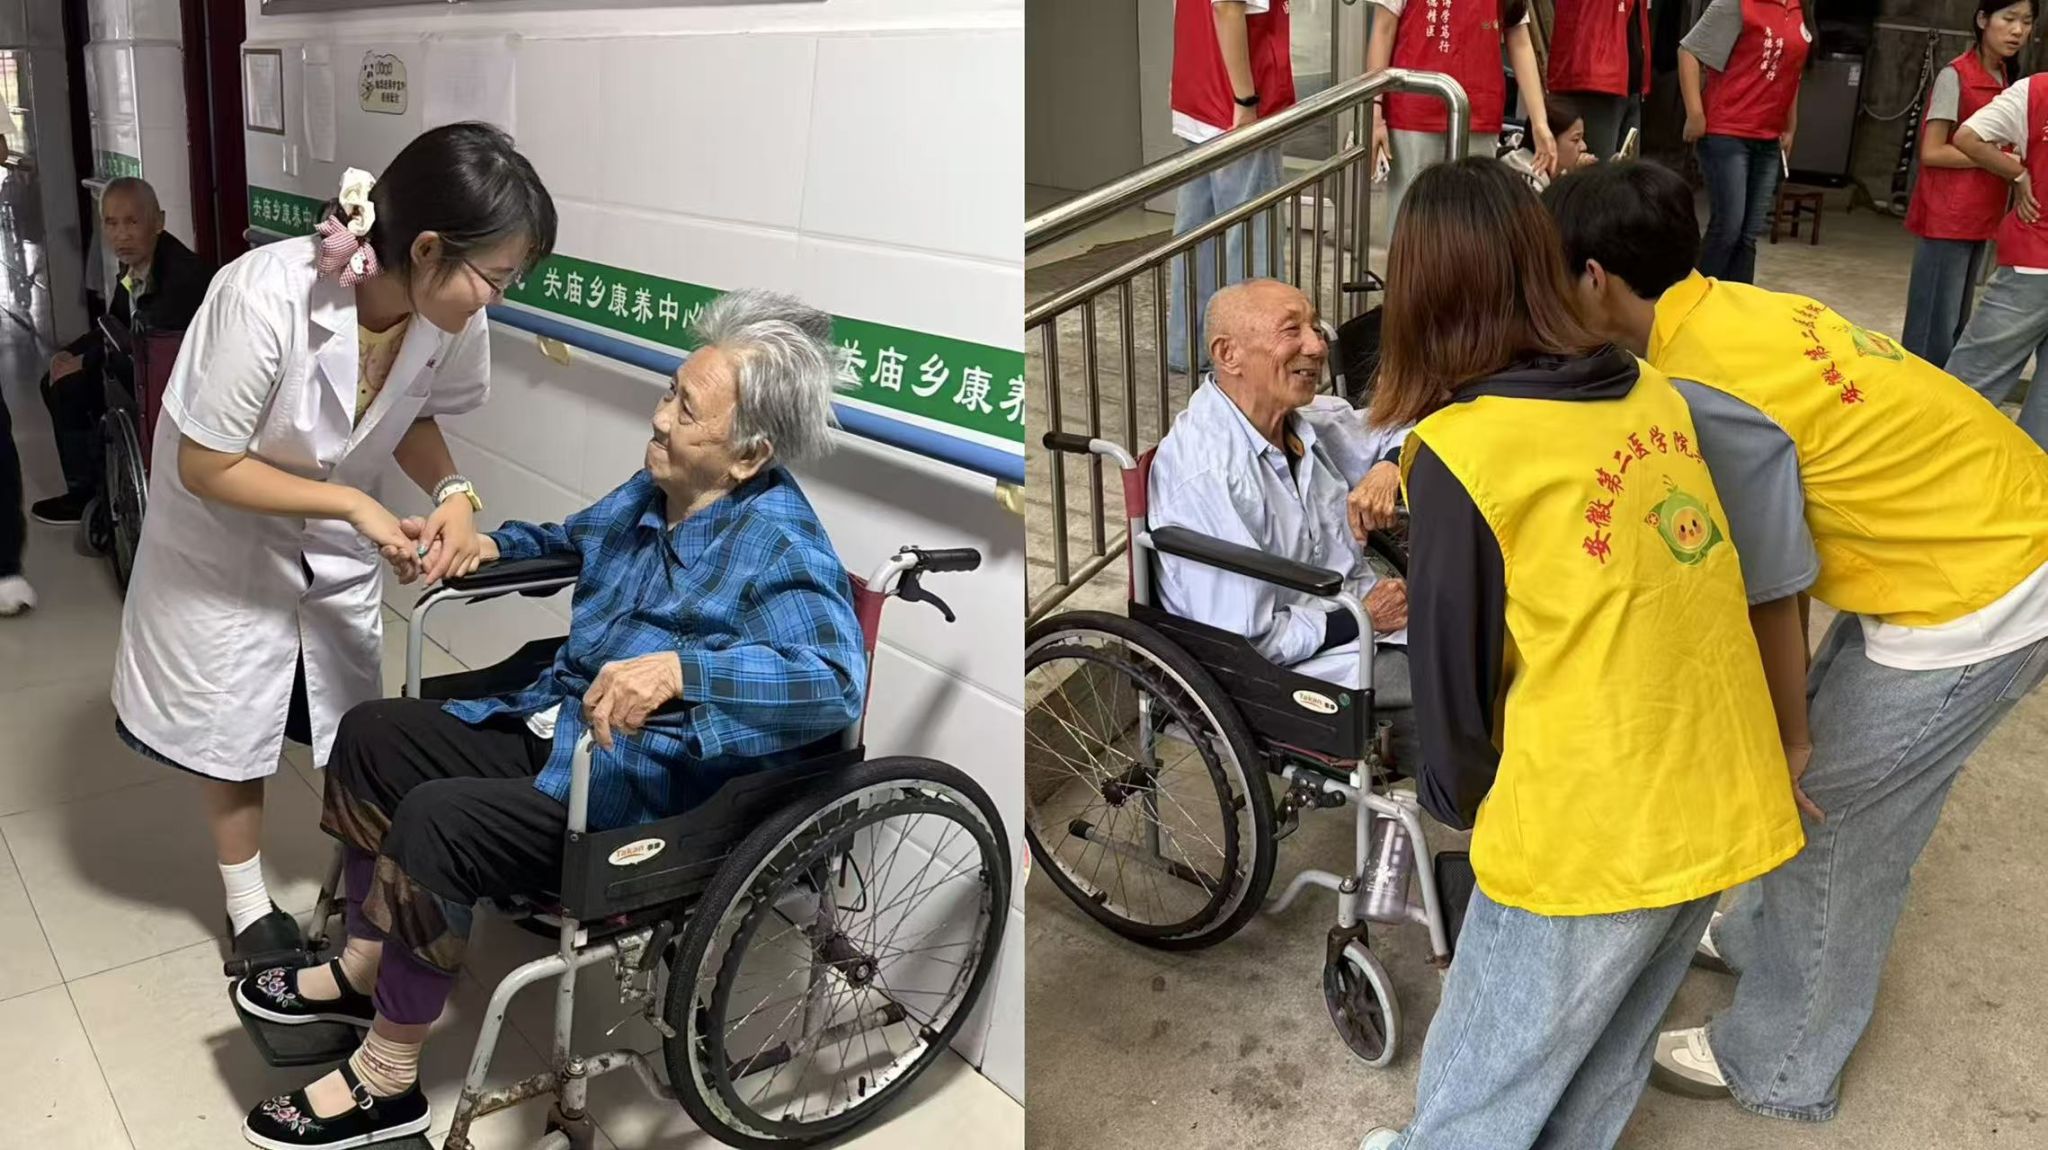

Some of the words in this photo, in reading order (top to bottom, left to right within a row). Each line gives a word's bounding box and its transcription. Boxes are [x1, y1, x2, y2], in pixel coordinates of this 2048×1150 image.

[1582, 425, 1703, 564] 安徽第二医学院
